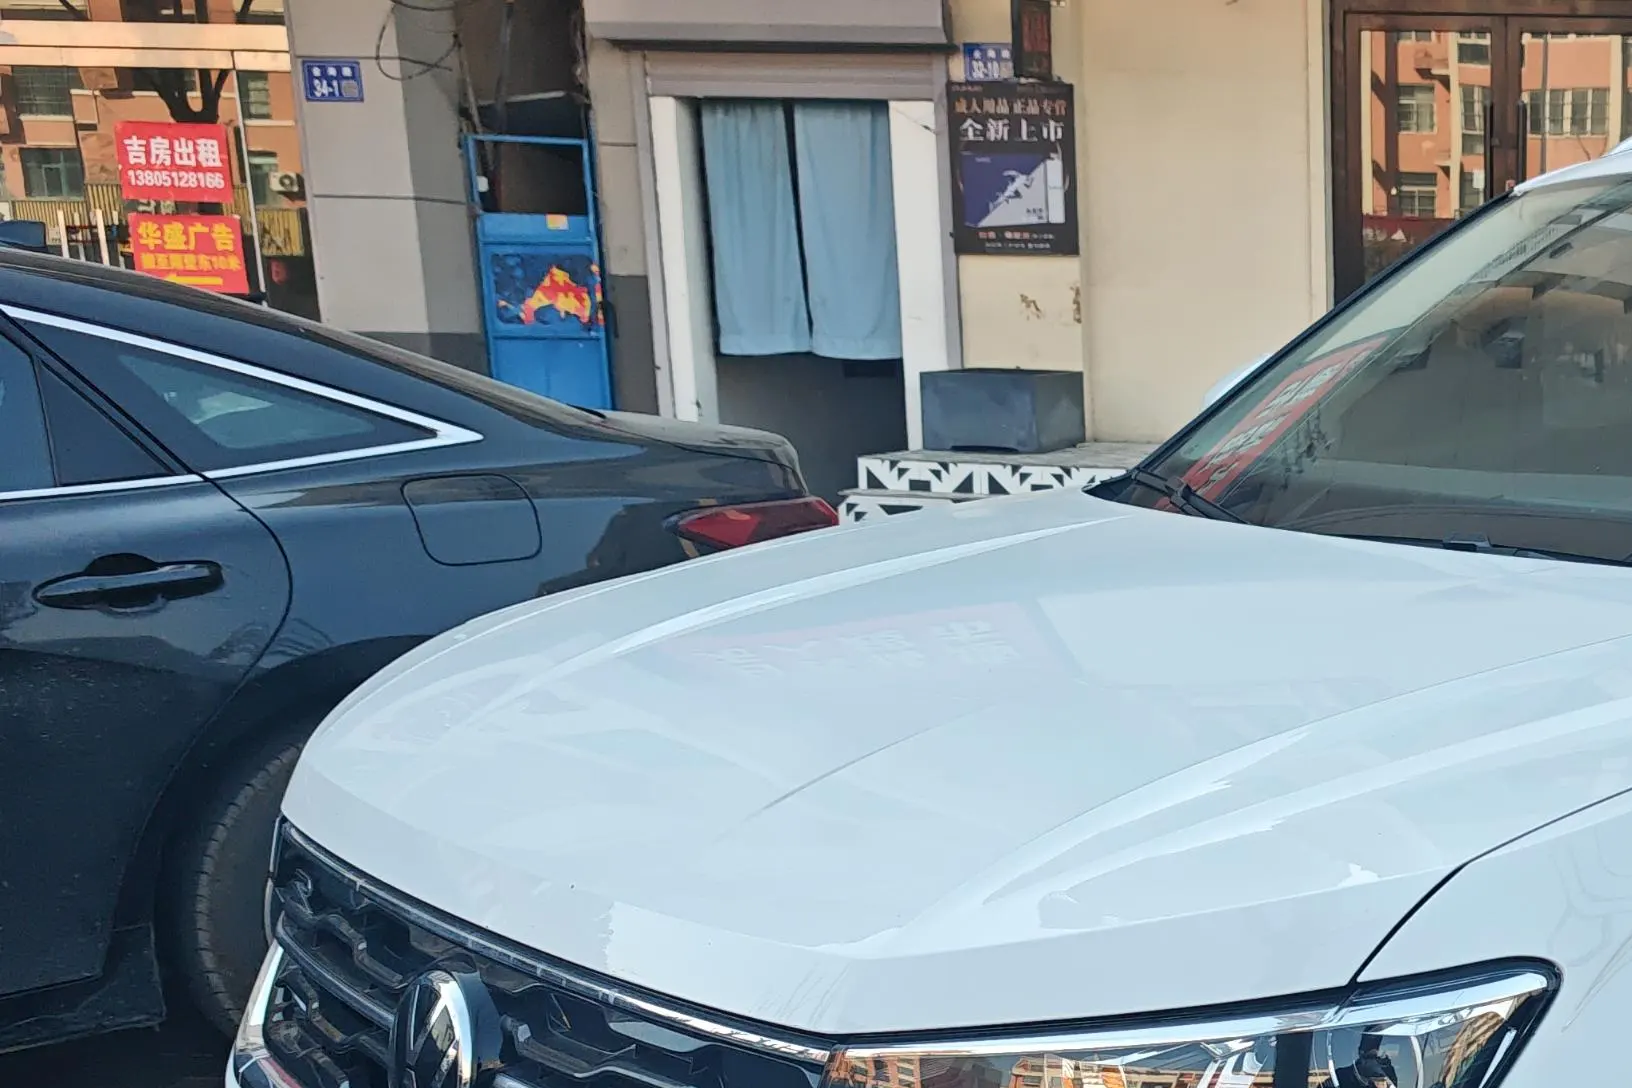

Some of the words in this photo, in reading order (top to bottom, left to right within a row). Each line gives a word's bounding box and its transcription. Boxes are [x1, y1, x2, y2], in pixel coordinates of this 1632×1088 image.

[960, 118, 1064, 142] 全新上市
[124, 135, 222, 167] 吉房出租
[128, 169, 225, 189] 13805128166
[137, 221, 235, 251] 华盛广告
